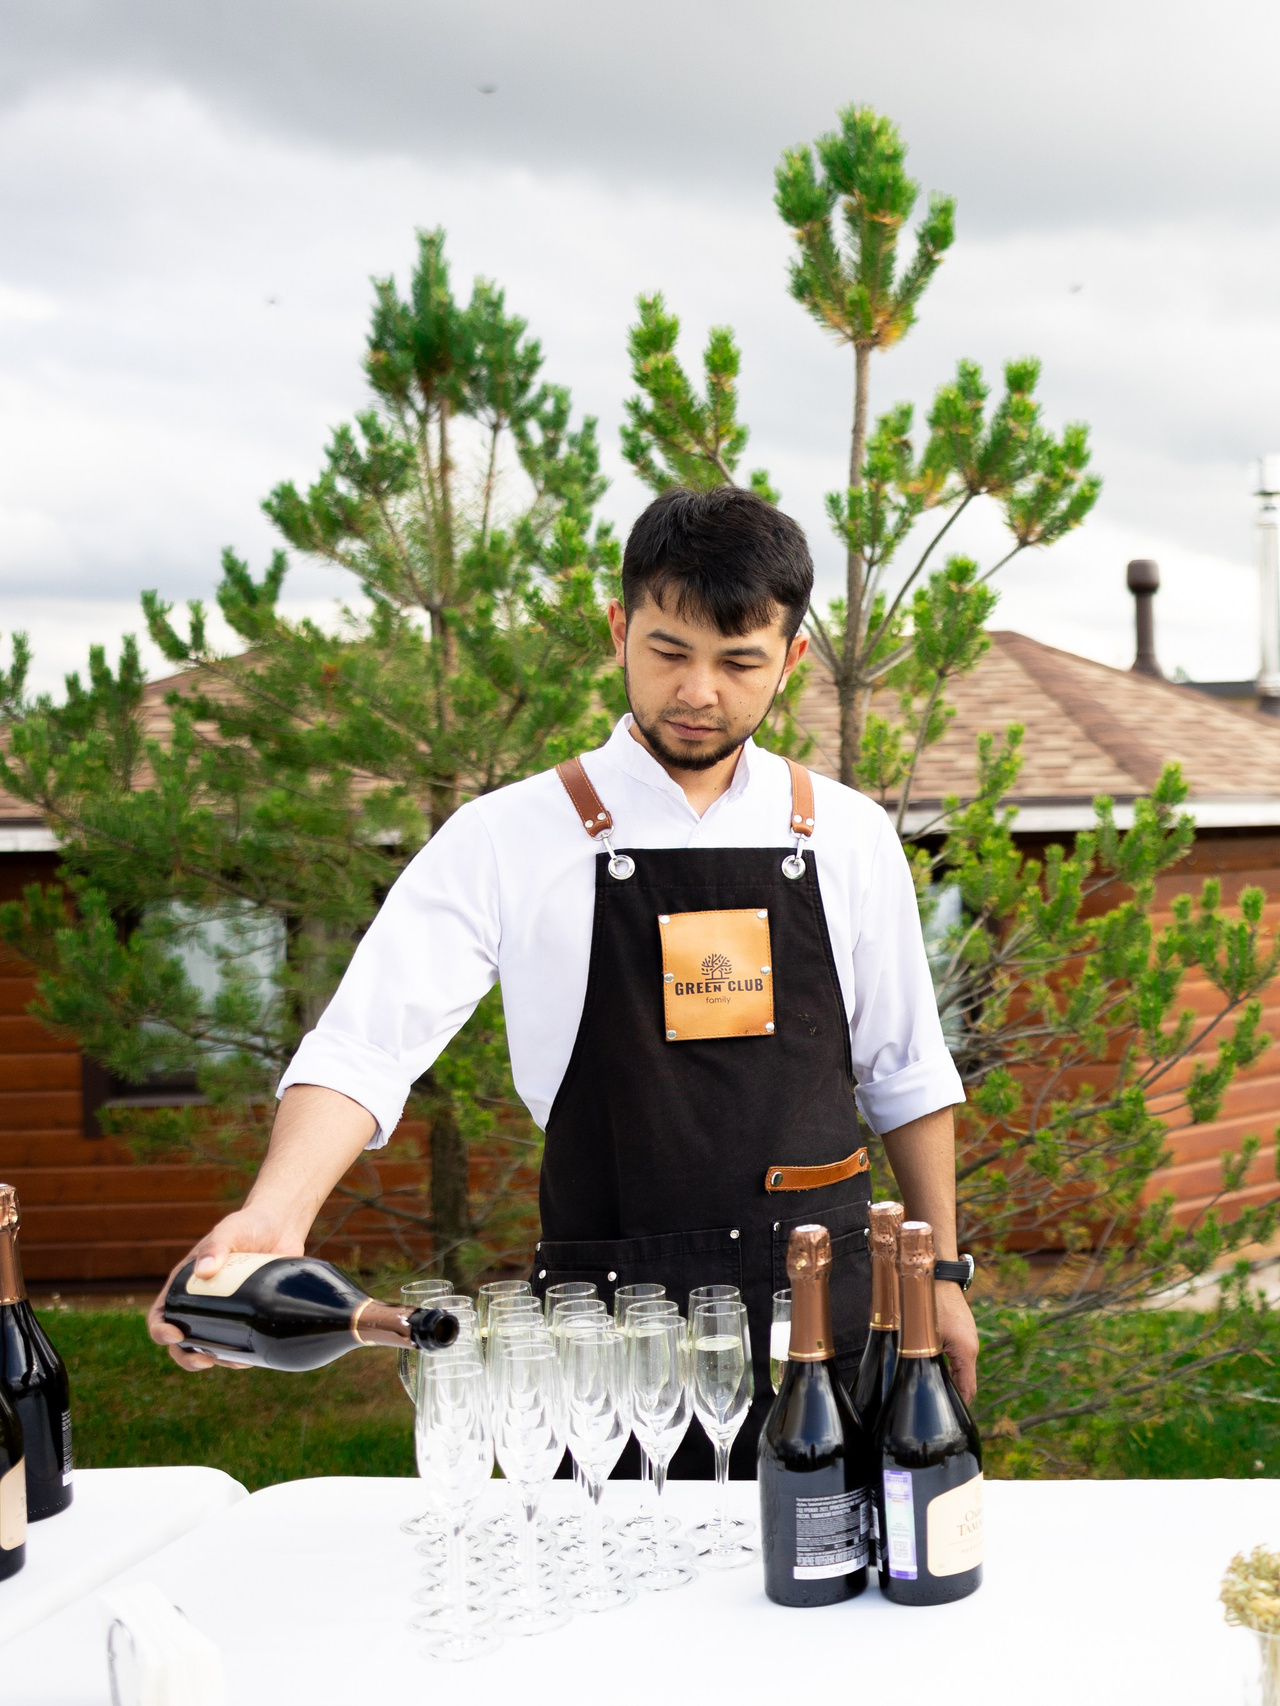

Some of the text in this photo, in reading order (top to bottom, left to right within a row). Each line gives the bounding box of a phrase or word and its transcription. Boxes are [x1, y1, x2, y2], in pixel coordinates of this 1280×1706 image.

[675, 978, 763, 996] GREEN CLUB
[705, 996, 731, 1004] family
